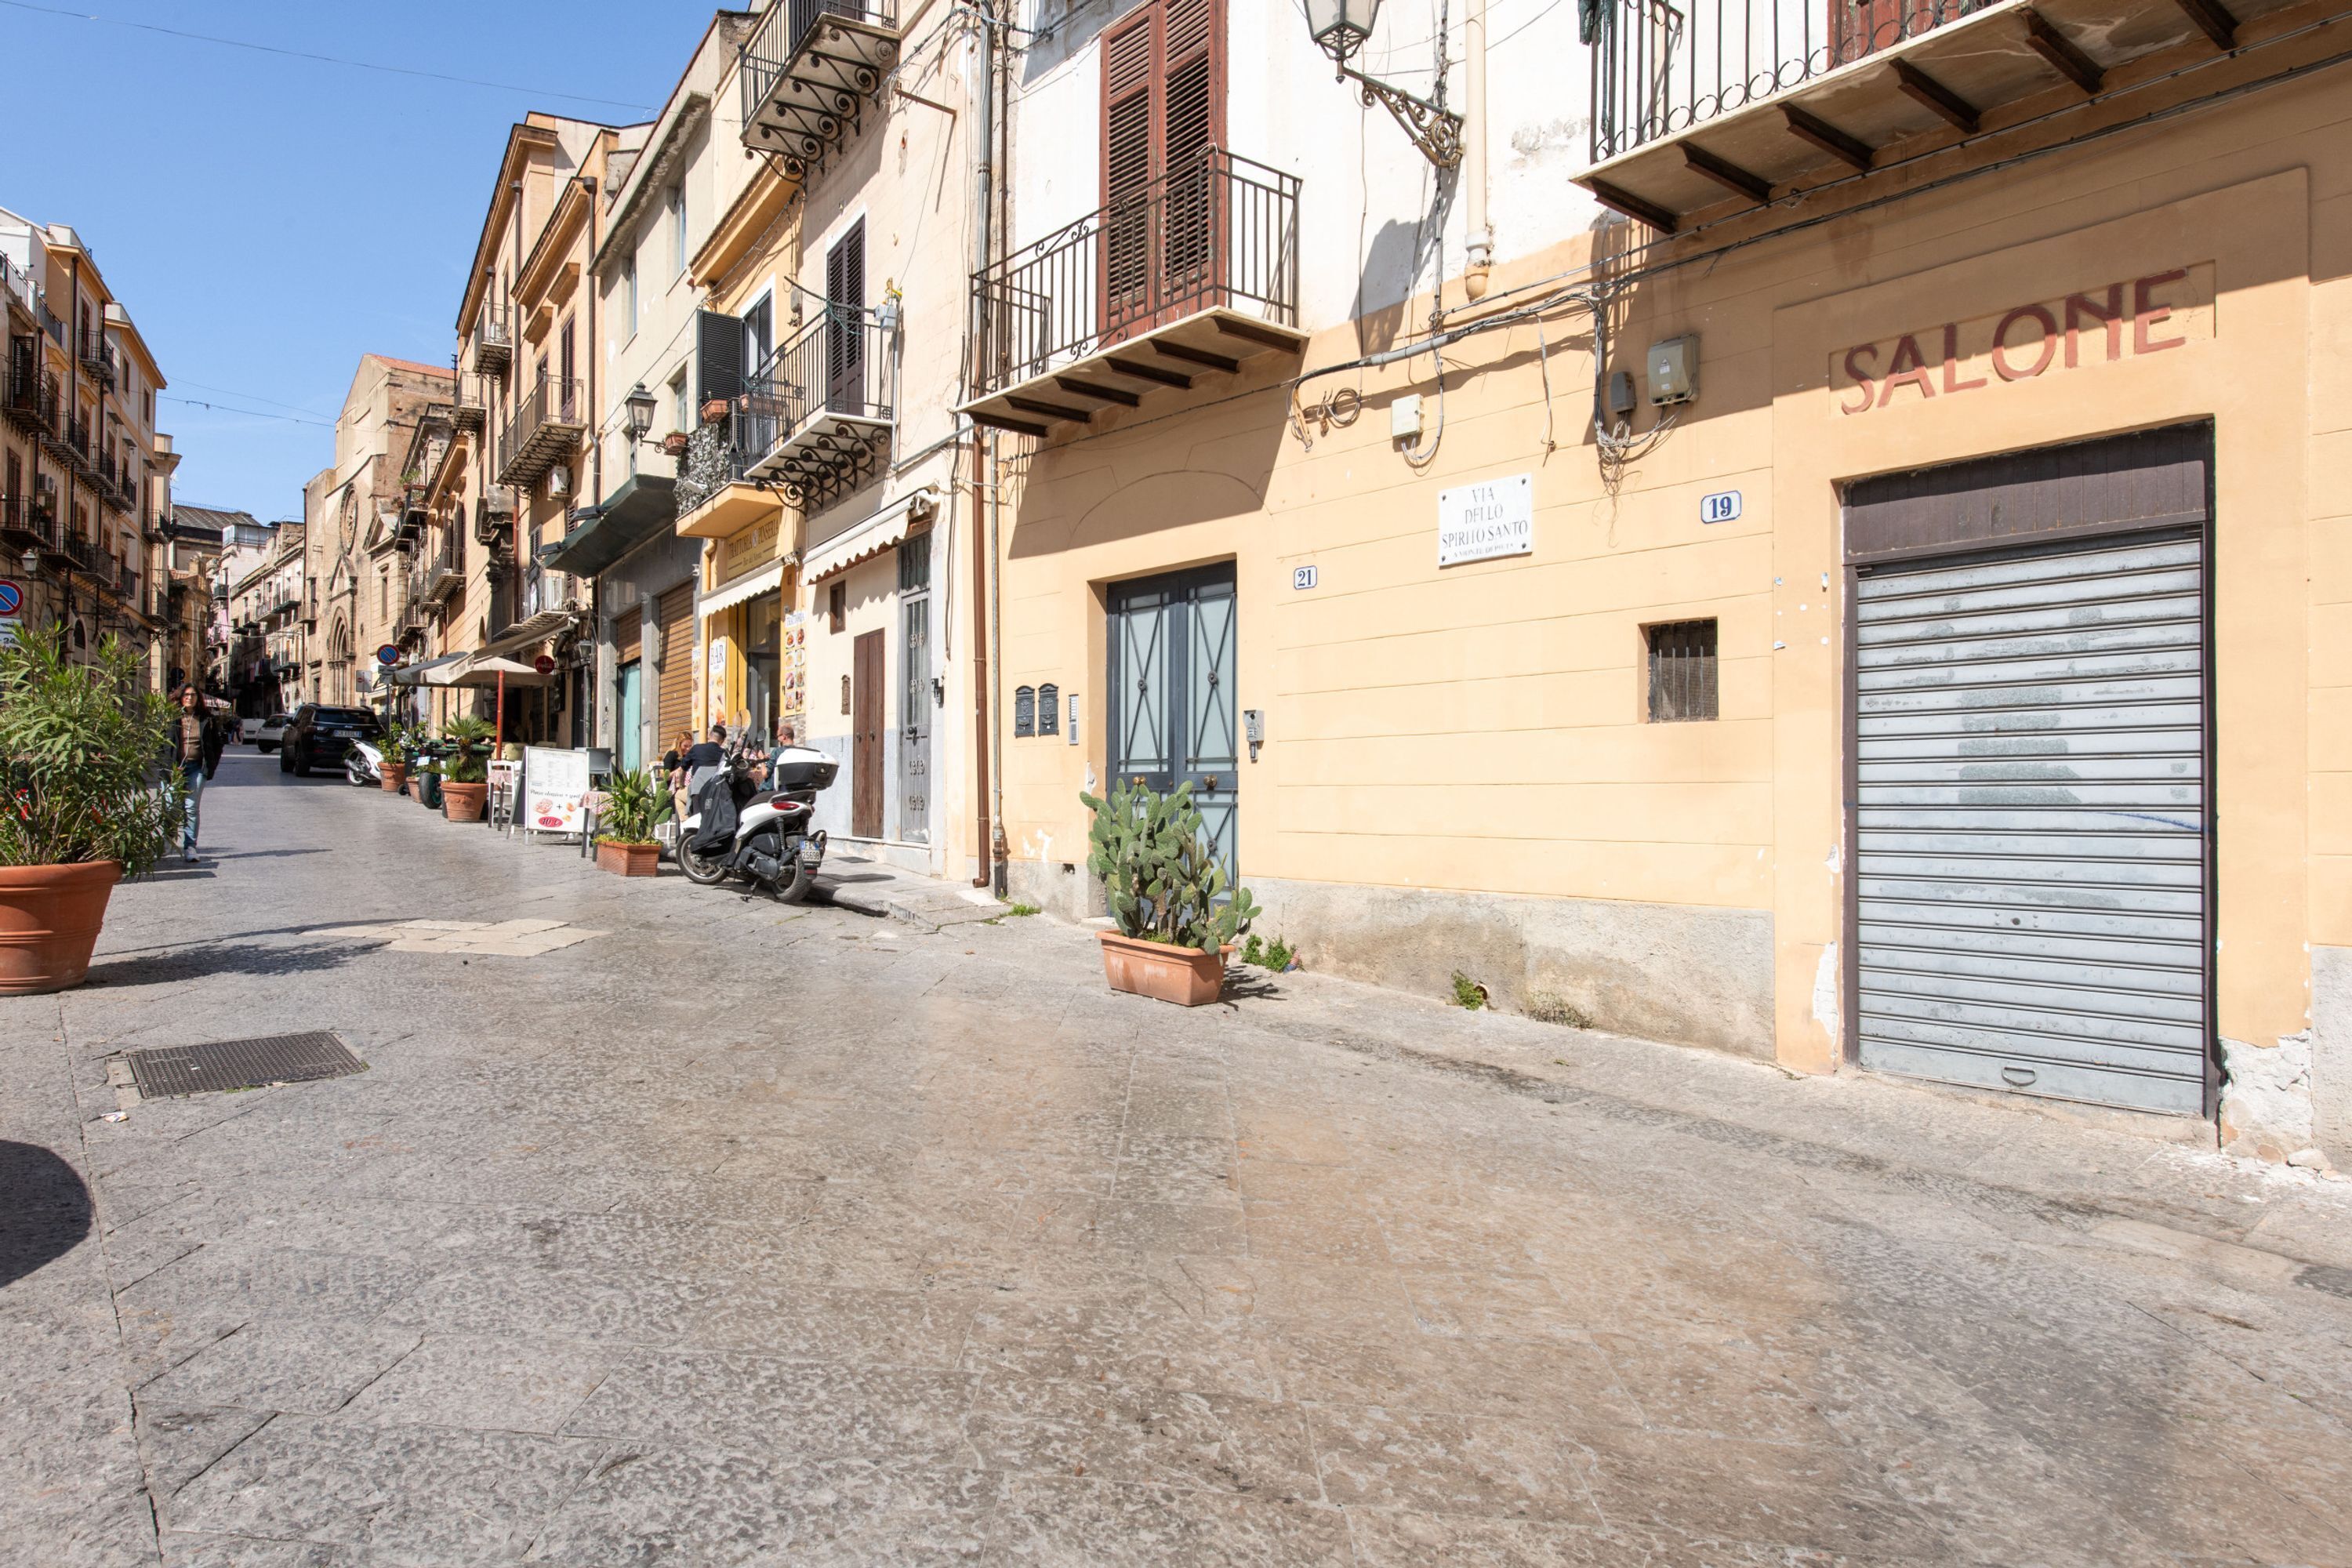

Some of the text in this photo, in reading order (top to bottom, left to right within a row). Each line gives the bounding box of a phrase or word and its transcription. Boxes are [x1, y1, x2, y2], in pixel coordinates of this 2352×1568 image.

[1841, 267, 2187, 416] SALONE
[1472, 487, 1494, 503] VIA
[1708, 495, 1732, 519] 19
[728, 518, 779, 560] TRATTORIA PINSERIA
[1442, 520, 1528, 549] SPIRITO SANTO
[1298, 569, 1312, 586] 21
[710, 644, 724, 666] BAR
